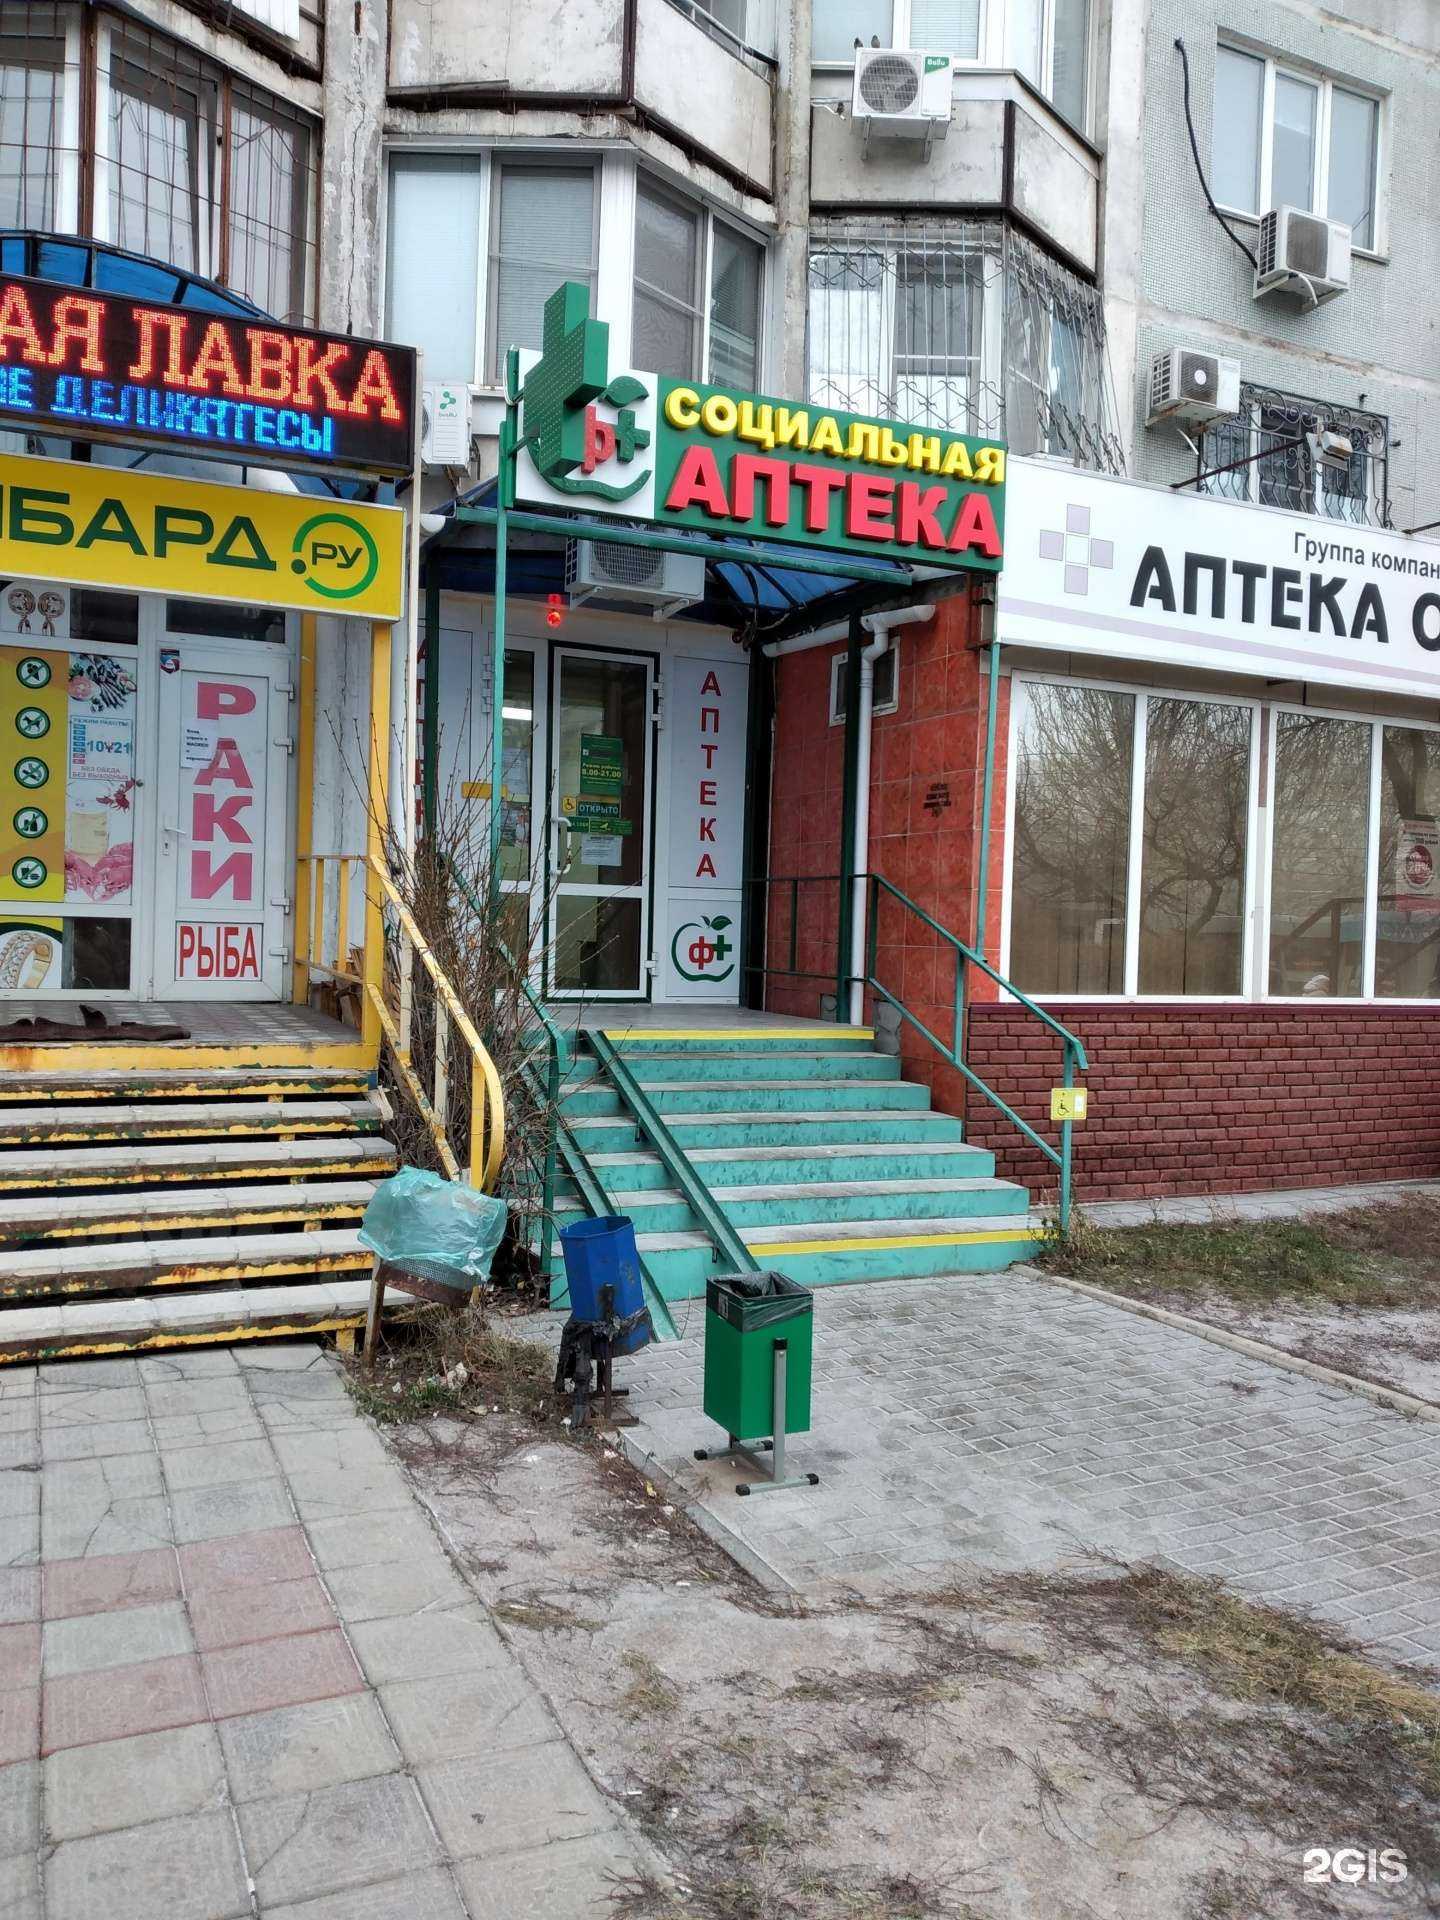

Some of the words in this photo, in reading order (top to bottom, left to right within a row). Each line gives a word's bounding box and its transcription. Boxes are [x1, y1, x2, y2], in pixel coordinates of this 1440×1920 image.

[129, 308, 401, 421] ЛАВКА
[50, 375, 334, 453] ДЕЛИКАТЕСЫ
[664, 386, 1005, 484] СОЦИАЛЬНАЯ
[0, 484, 277, 572] БАРД
[664, 445, 1004, 558] АПТЕКА
[1130, 544, 1390, 644] АПТЕКА
[1294, 531, 1365, 567] Группа
[1371, 551, 1440, 579] компан
[191, 681, 257, 901] РАКИ
[579, 804, 619, 814] ОТКРЫТО
[695, 670, 722, 879] АПТЕКА
[179, 925, 259, 978] РЫБА
